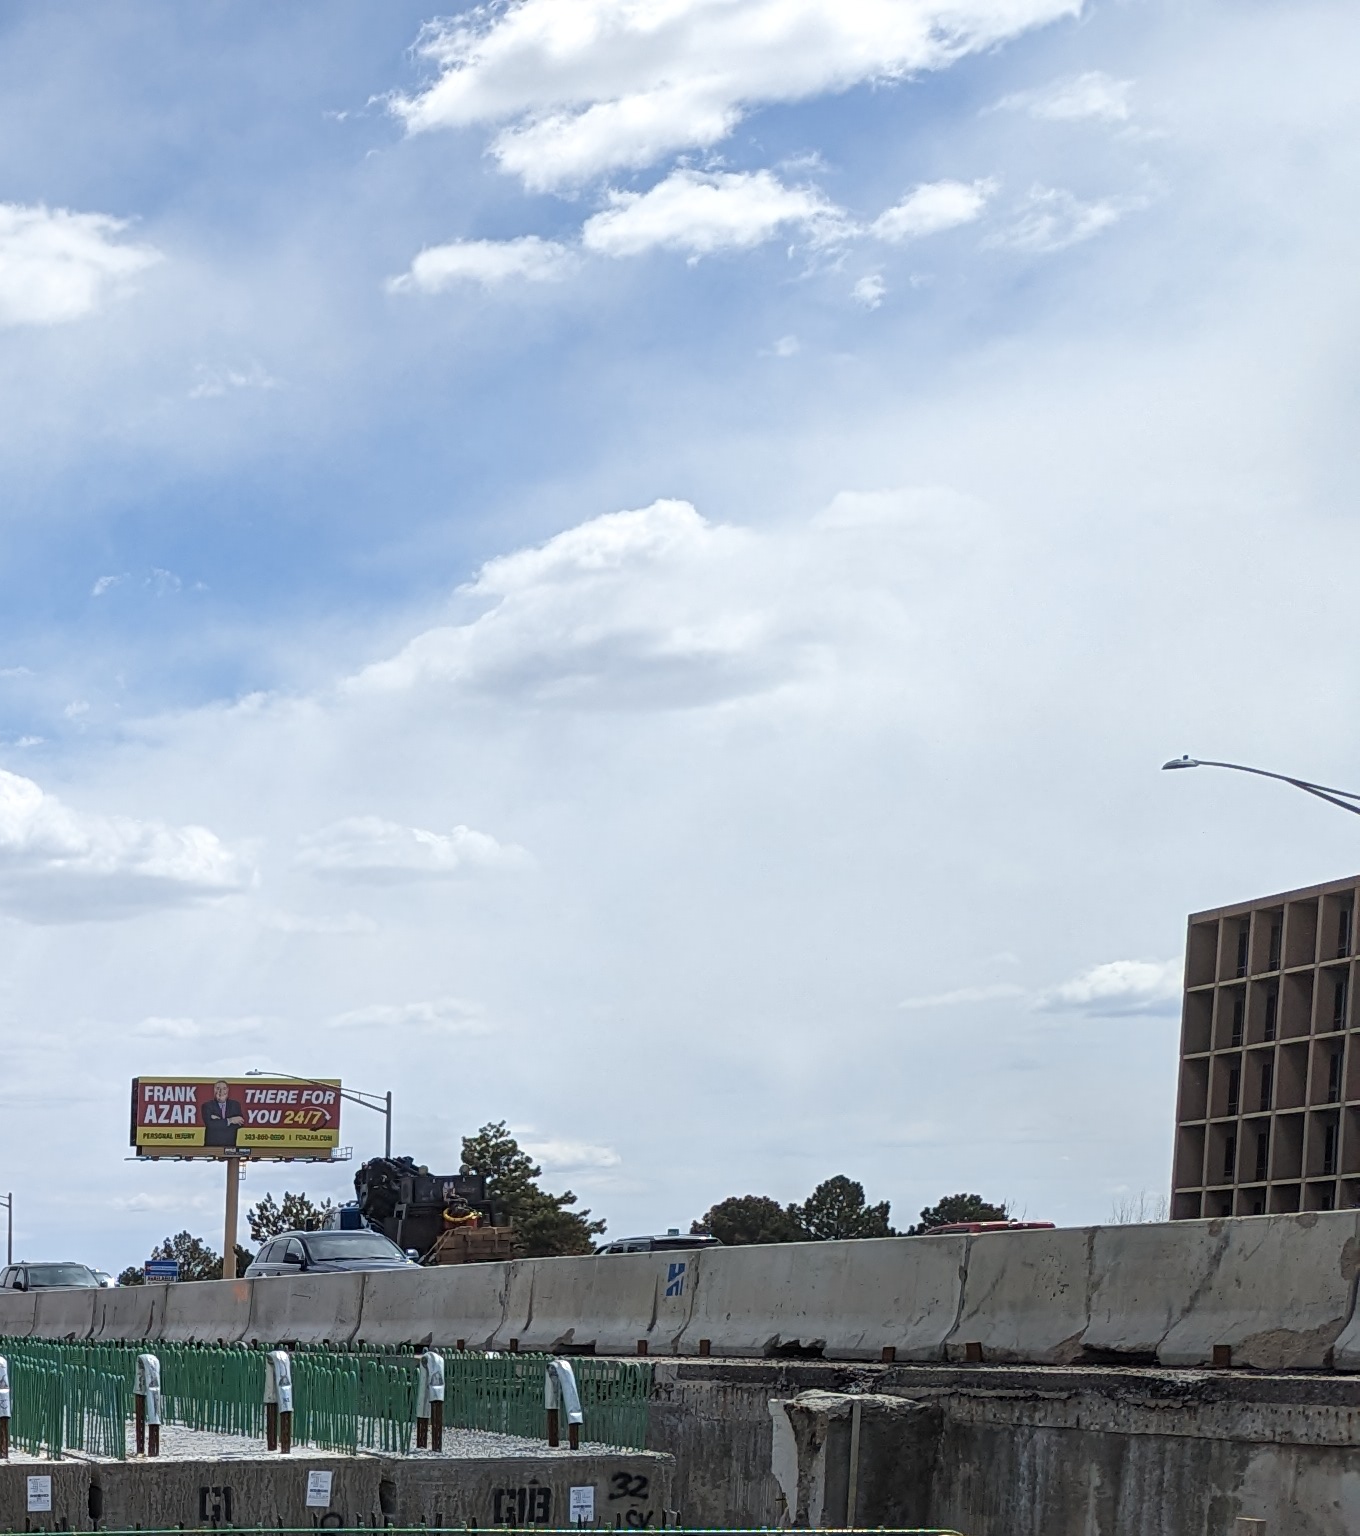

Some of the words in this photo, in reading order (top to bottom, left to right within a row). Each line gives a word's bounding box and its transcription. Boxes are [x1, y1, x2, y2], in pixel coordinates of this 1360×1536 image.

[144, 1086, 196, 1103] FRANK
[245, 1089, 299, 1104] THERE
[300, 1090, 335, 1105] FOR
[143, 1104, 196, 1124] AZAR
[247, 1109, 281, 1124] YOU
[283, 1110, 322, 1125] 24/7
[608, 1471, 649, 1500] 32
